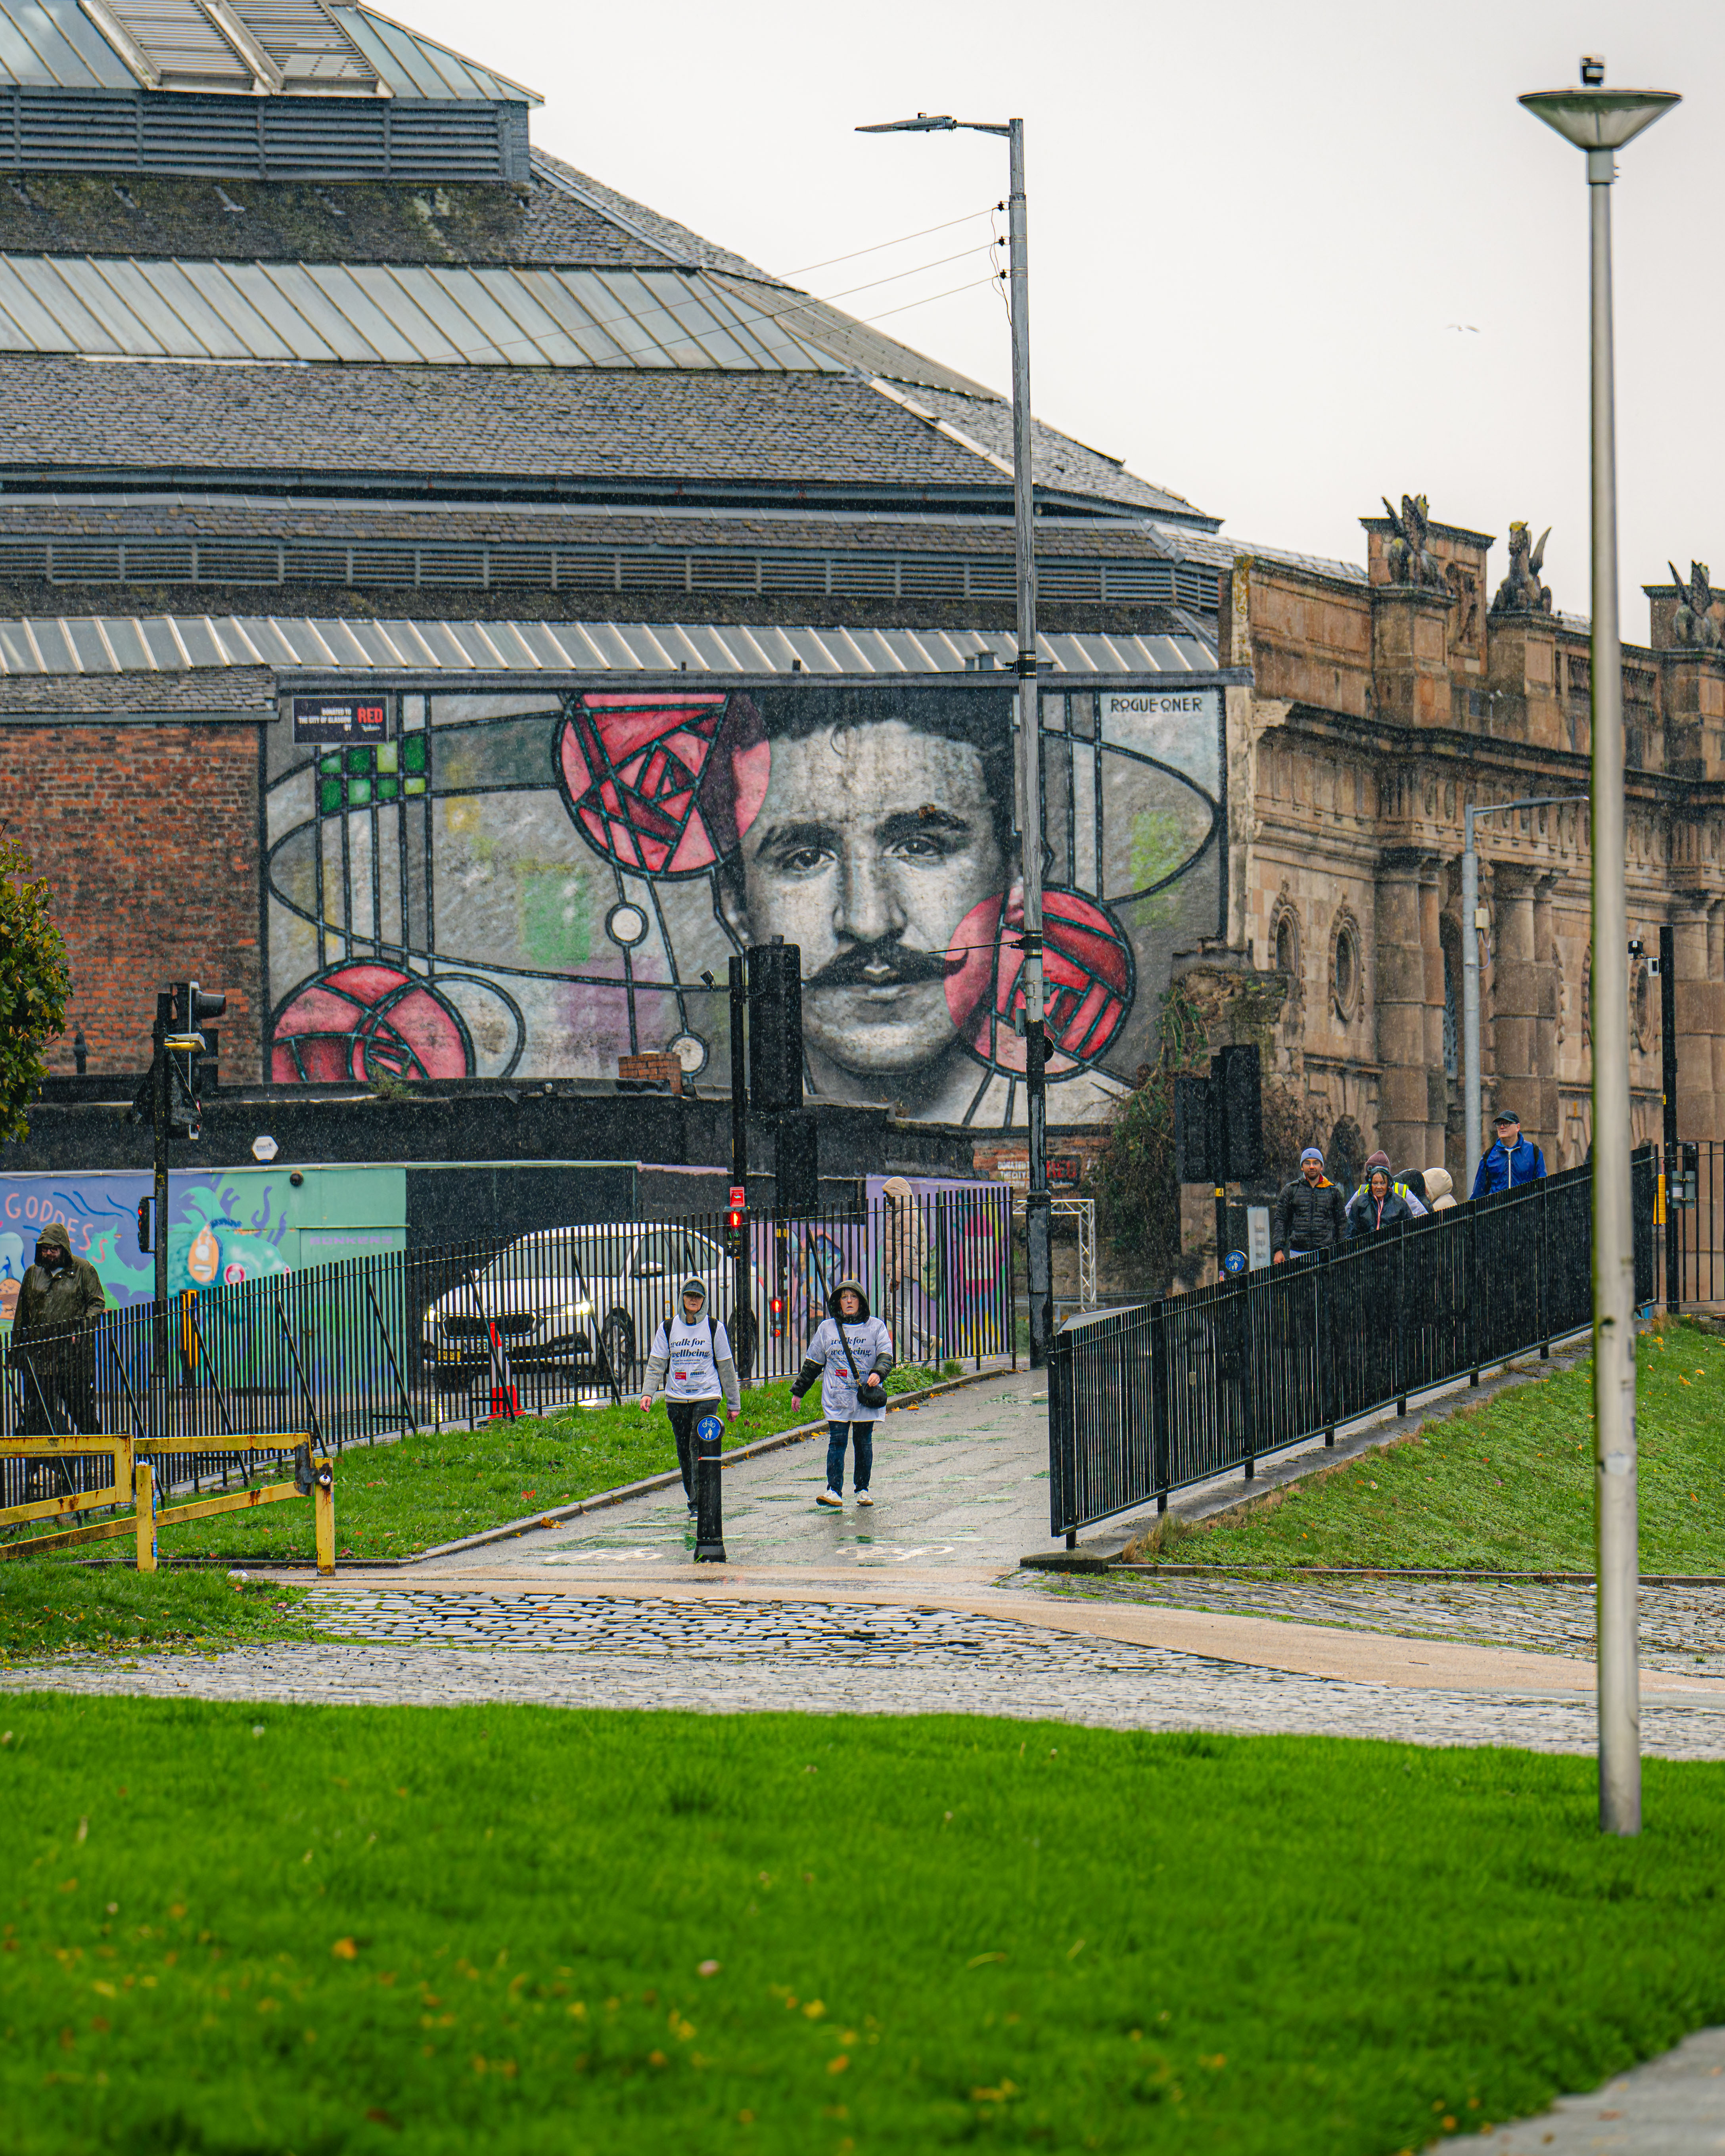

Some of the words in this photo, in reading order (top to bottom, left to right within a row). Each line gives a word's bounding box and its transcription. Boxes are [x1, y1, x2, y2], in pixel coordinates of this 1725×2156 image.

[358, 707, 383, 723] RED
[5, 1193, 108, 1263] GODDESS
[670, 1338, 690, 1347] walk
[690, 1338, 705, 1347] for
[853, 1336, 866, 1345] for
[671, 1349, 710, 1359] wellbeing.
